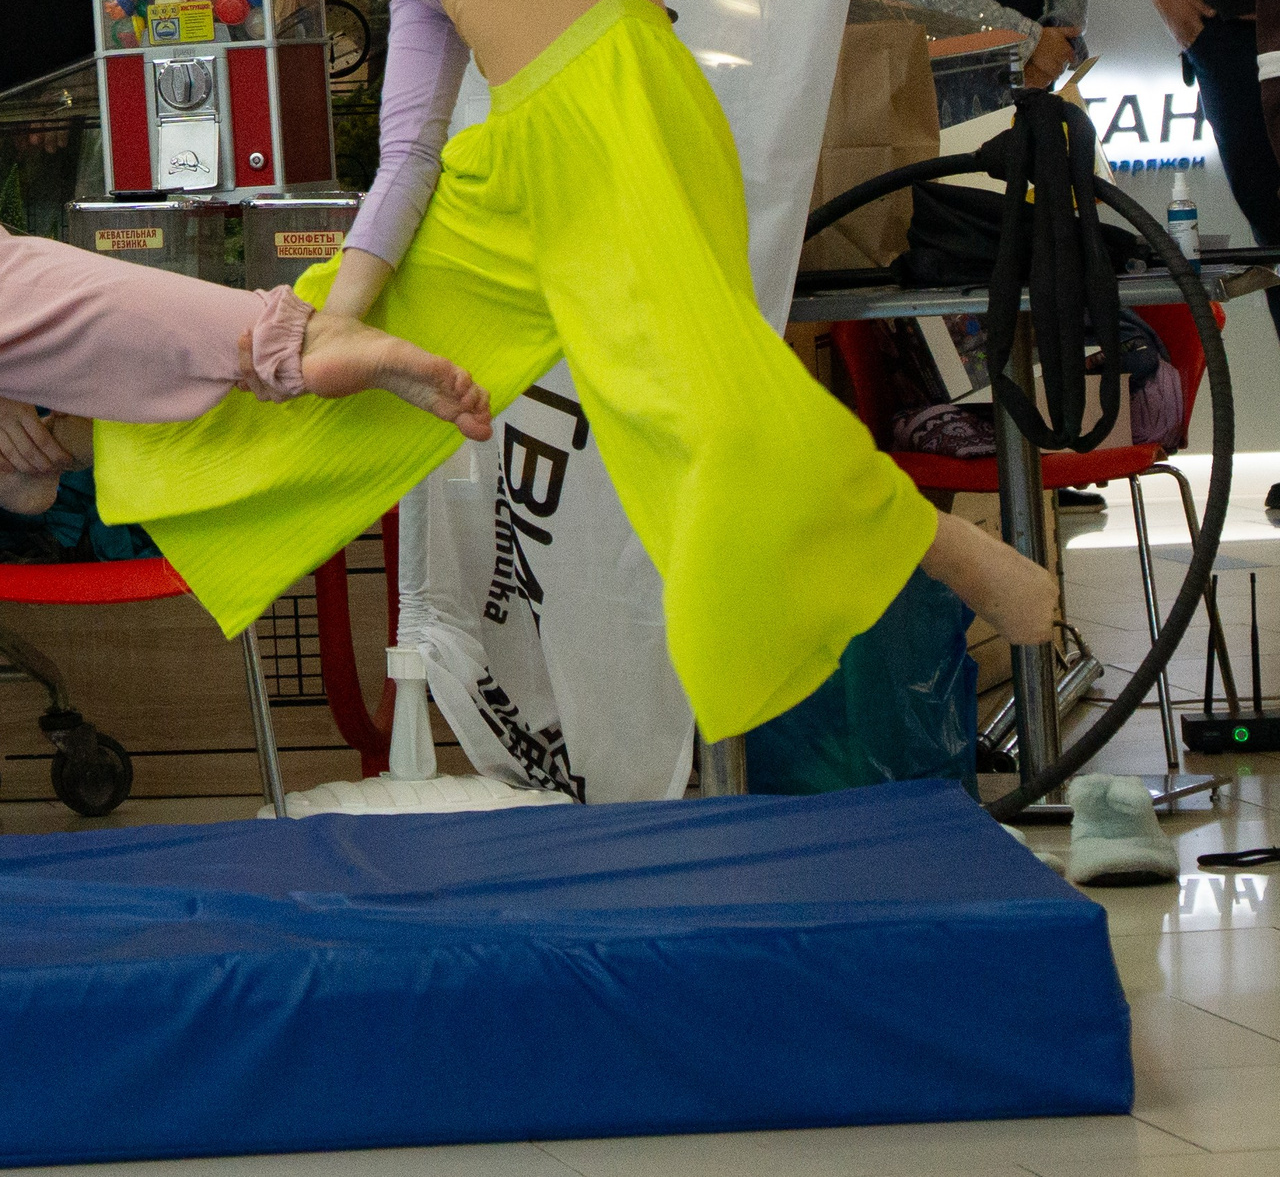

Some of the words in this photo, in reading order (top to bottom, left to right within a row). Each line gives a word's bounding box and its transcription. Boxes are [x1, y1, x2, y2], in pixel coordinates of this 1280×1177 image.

[99, 229, 157, 240] ЖЕВАТЕЛЬНАЯ
[283, 233, 335, 244] КОНФЕТЫ
[111, 239, 148, 249] РЕЗИНКА
[278, 247, 323, 256] НЕСКОЛЬКО
[324, 247, 339, 256] ШТ
